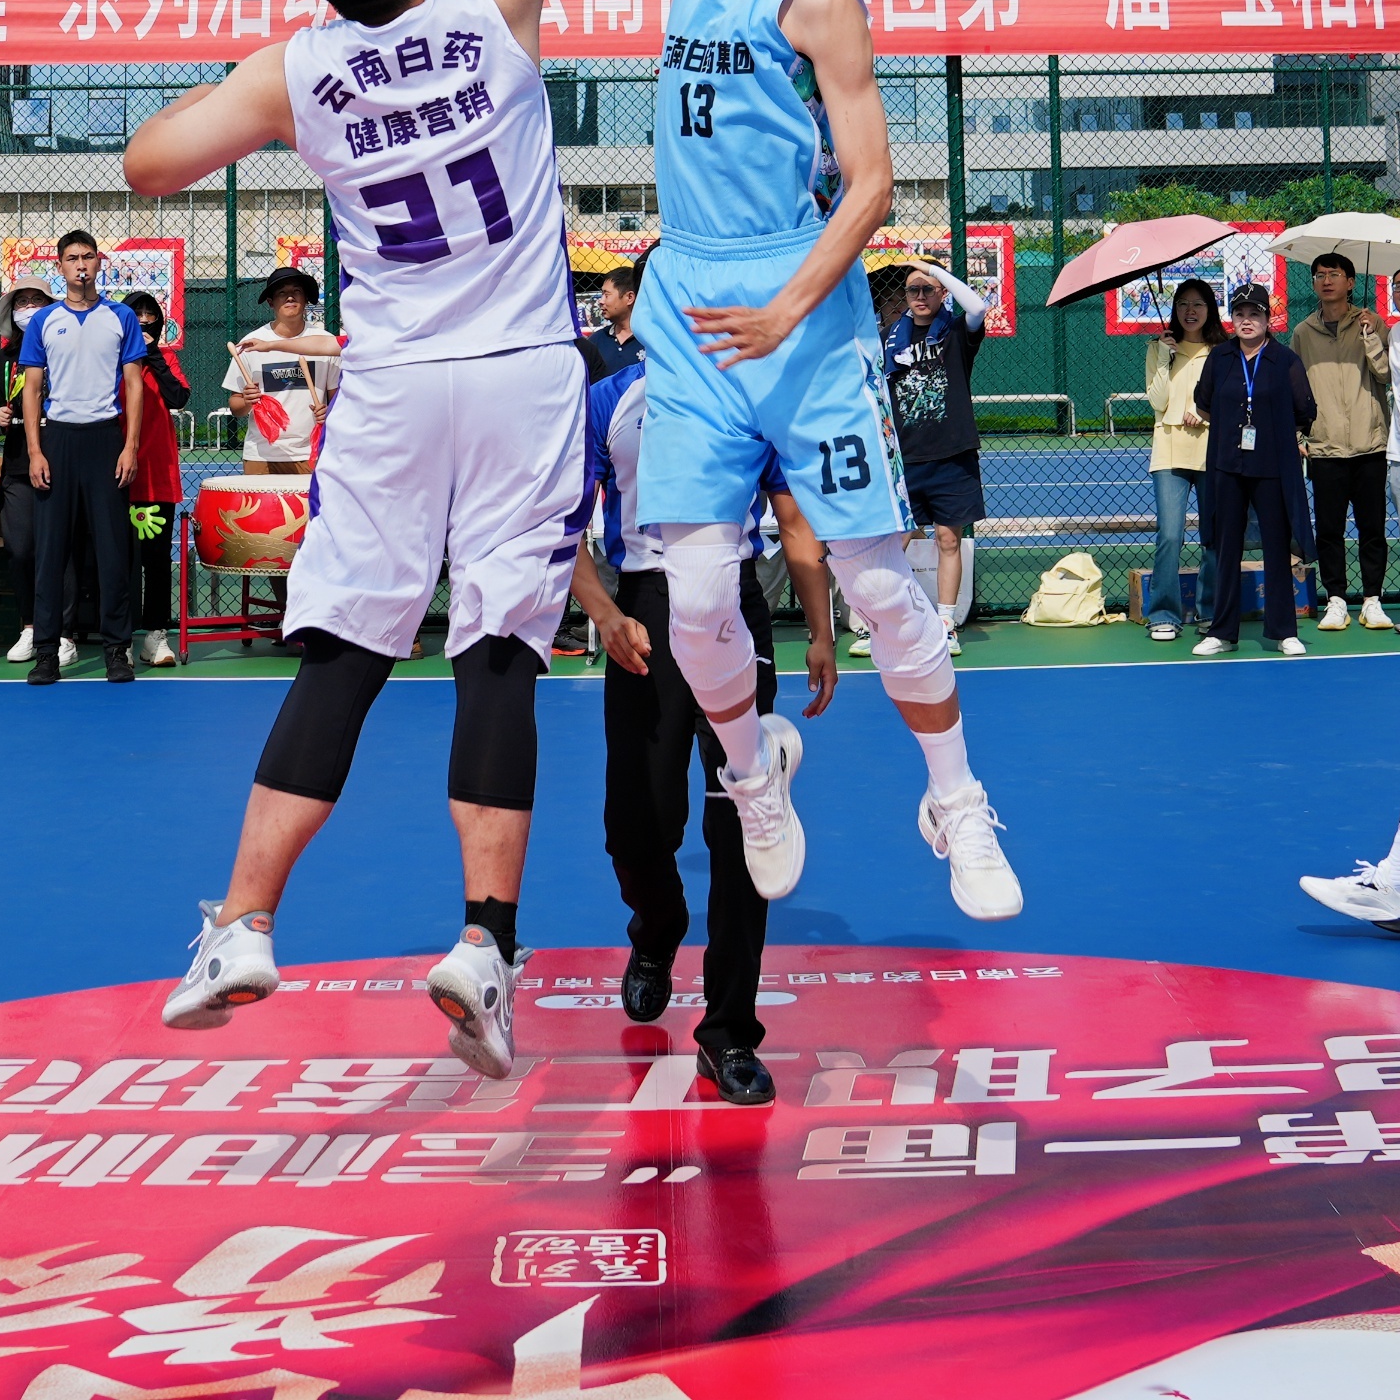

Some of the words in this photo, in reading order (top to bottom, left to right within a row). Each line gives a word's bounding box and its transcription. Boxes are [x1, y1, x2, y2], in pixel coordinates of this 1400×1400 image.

[312, 30, 484, 115] 云南白药
[345, 80, 495, 160] 健康营销
[679, 82, 716, 139] 13
[819, 433, 872, 495] 13
